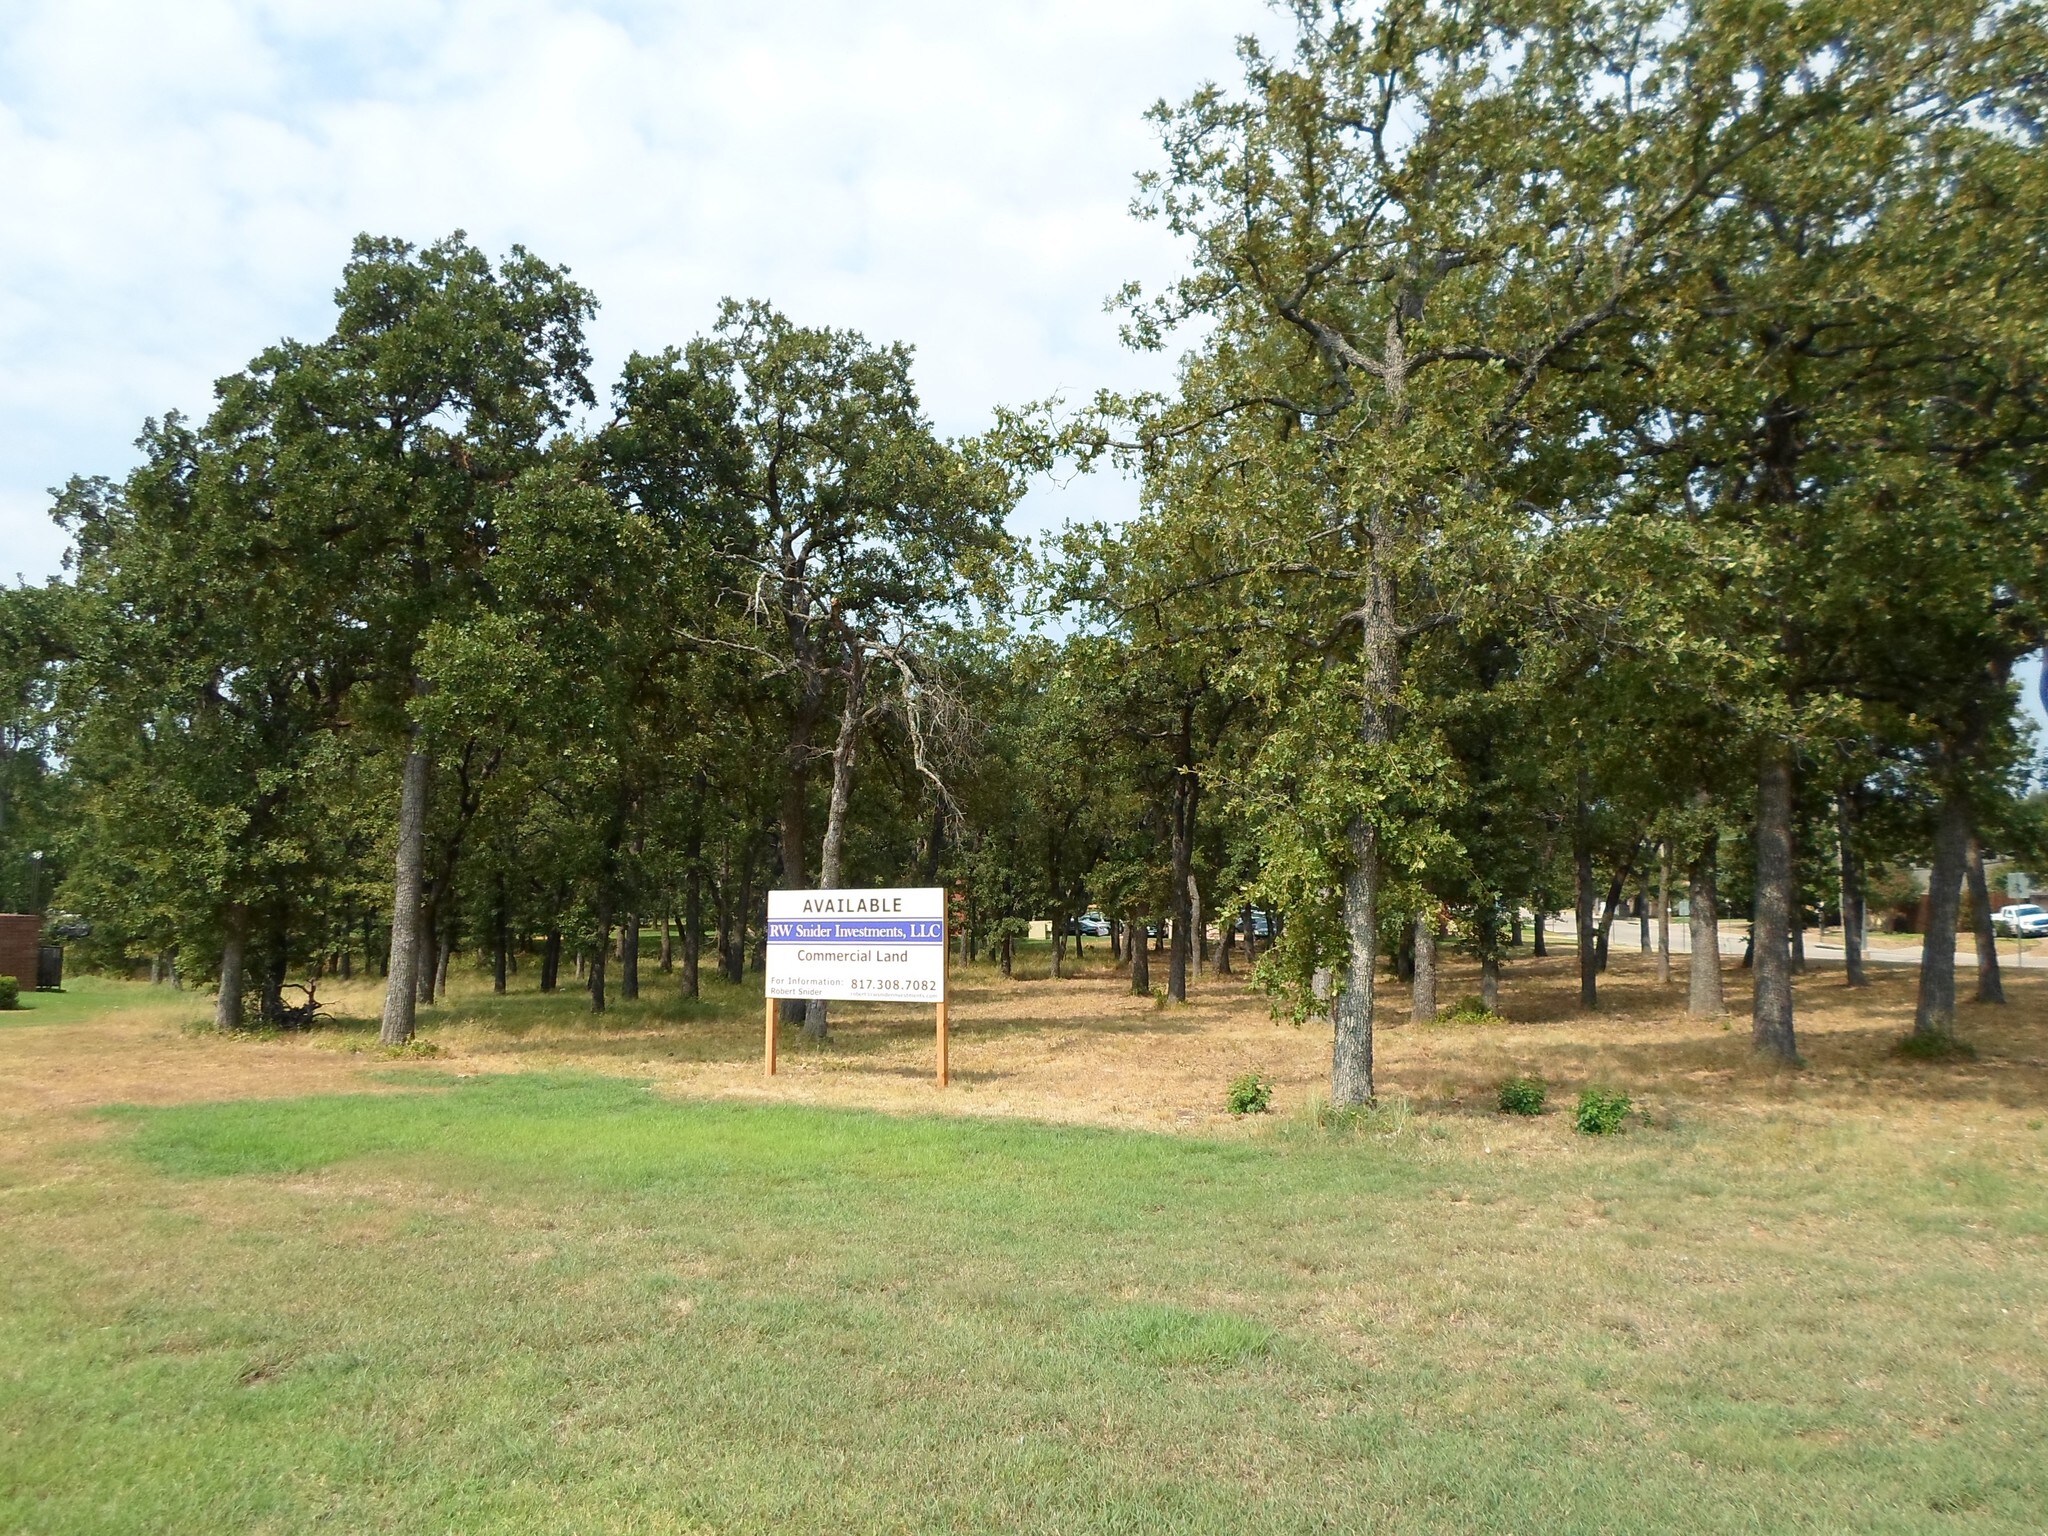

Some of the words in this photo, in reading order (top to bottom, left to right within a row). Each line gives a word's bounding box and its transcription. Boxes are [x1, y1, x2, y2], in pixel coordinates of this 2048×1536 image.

[803, 898, 902, 913] AVAILABLE
[769, 924, 793, 937] RW
[796, 924, 832, 938] Snider
[835, 924, 907, 939] Investments,
[910, 924, 941, 938] LLC
[797, 949, 872, 962] Commercial
[876, 950, 908, 962] Land
[771, 976, 784, 985] For
[788, 977, 844, 986] Information:
[851, 979, 937, 991] 817.308.7082
[798, 988, 823, 996] Snider
